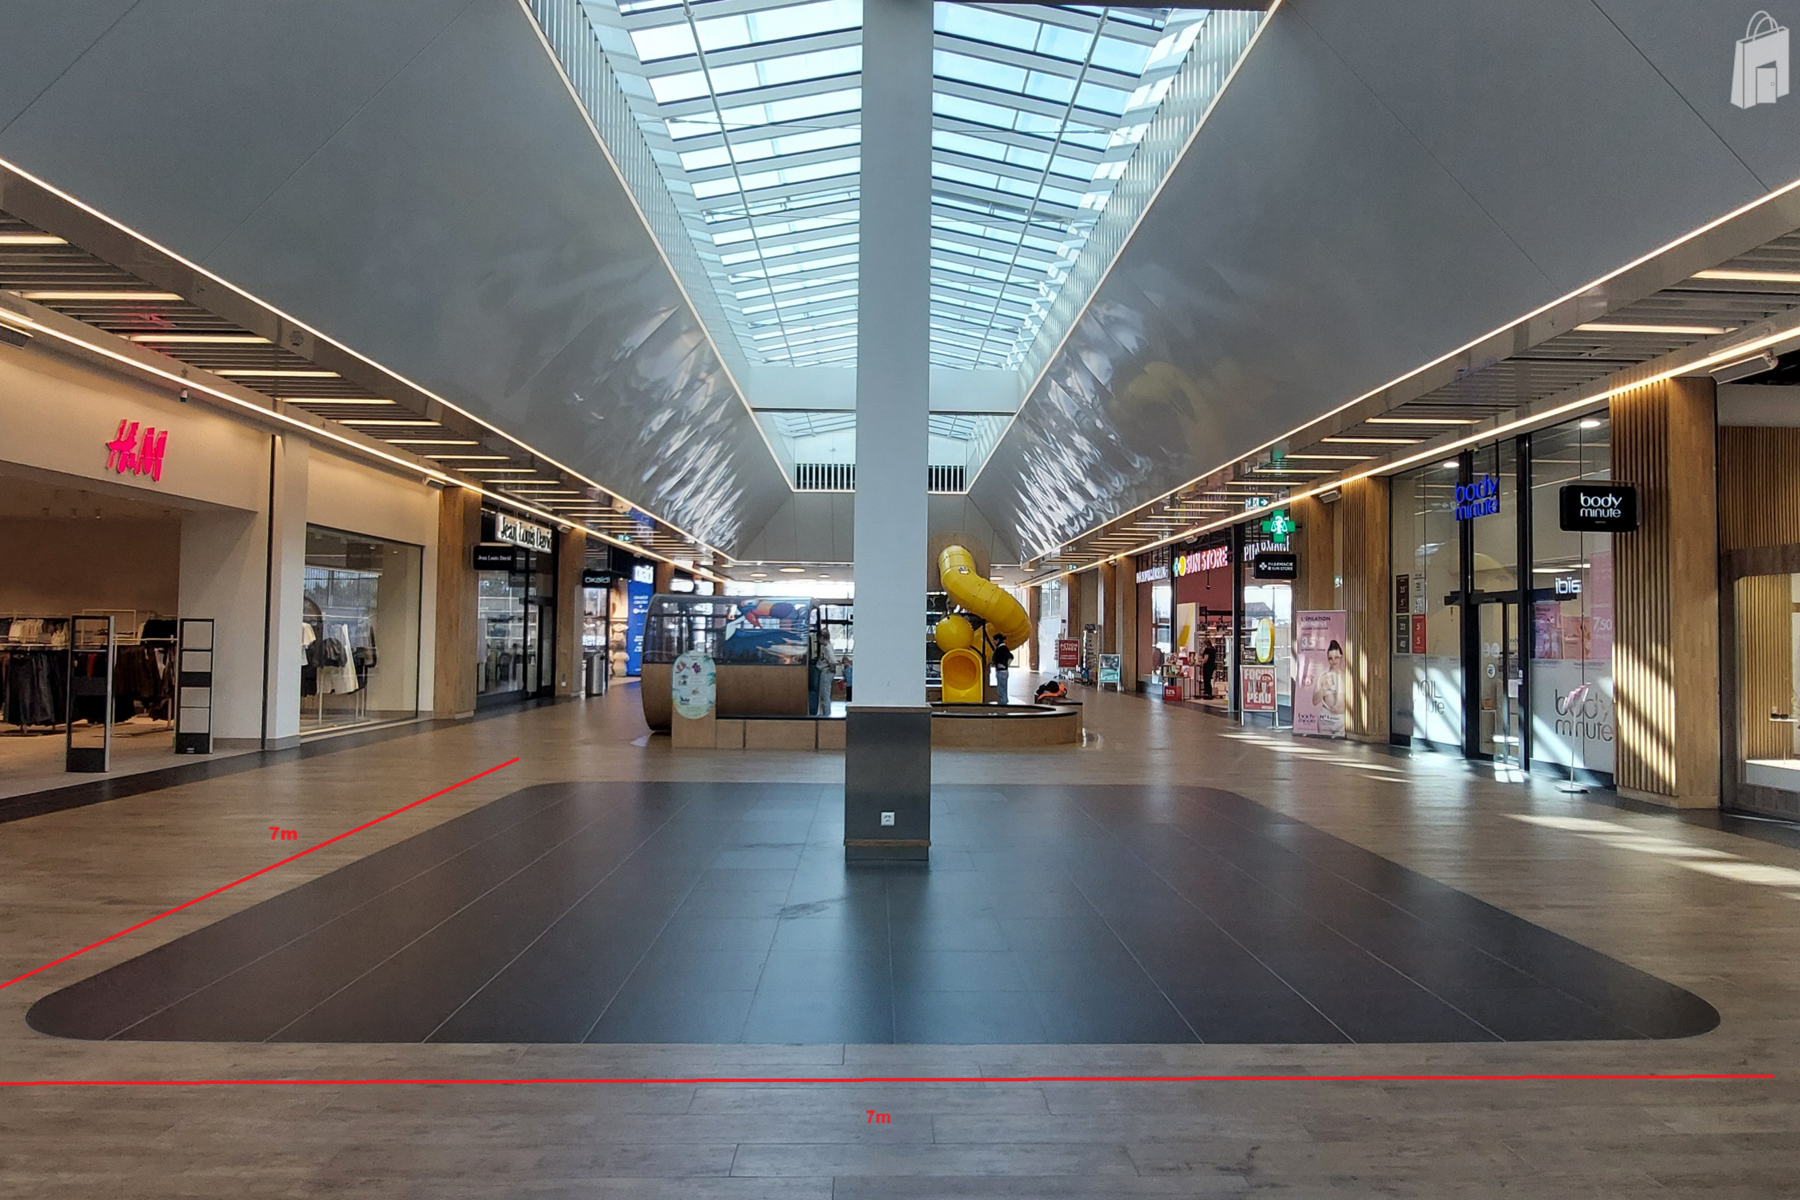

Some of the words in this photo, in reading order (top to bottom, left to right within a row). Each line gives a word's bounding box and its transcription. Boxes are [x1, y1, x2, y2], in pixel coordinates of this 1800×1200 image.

[107, 418, 168, 482] H&M
[1455, 474, 1499, 504] body
[1580, 493, 1622, 508] body
[1455, 498, 1500, 521] minute
[1580, 508, 1621, 518] minute
[1185, 552, 1200, 574] SUN
[1201, 546, 1228, 571] STORE
[1246, 692, 1272, 704] PEAU
